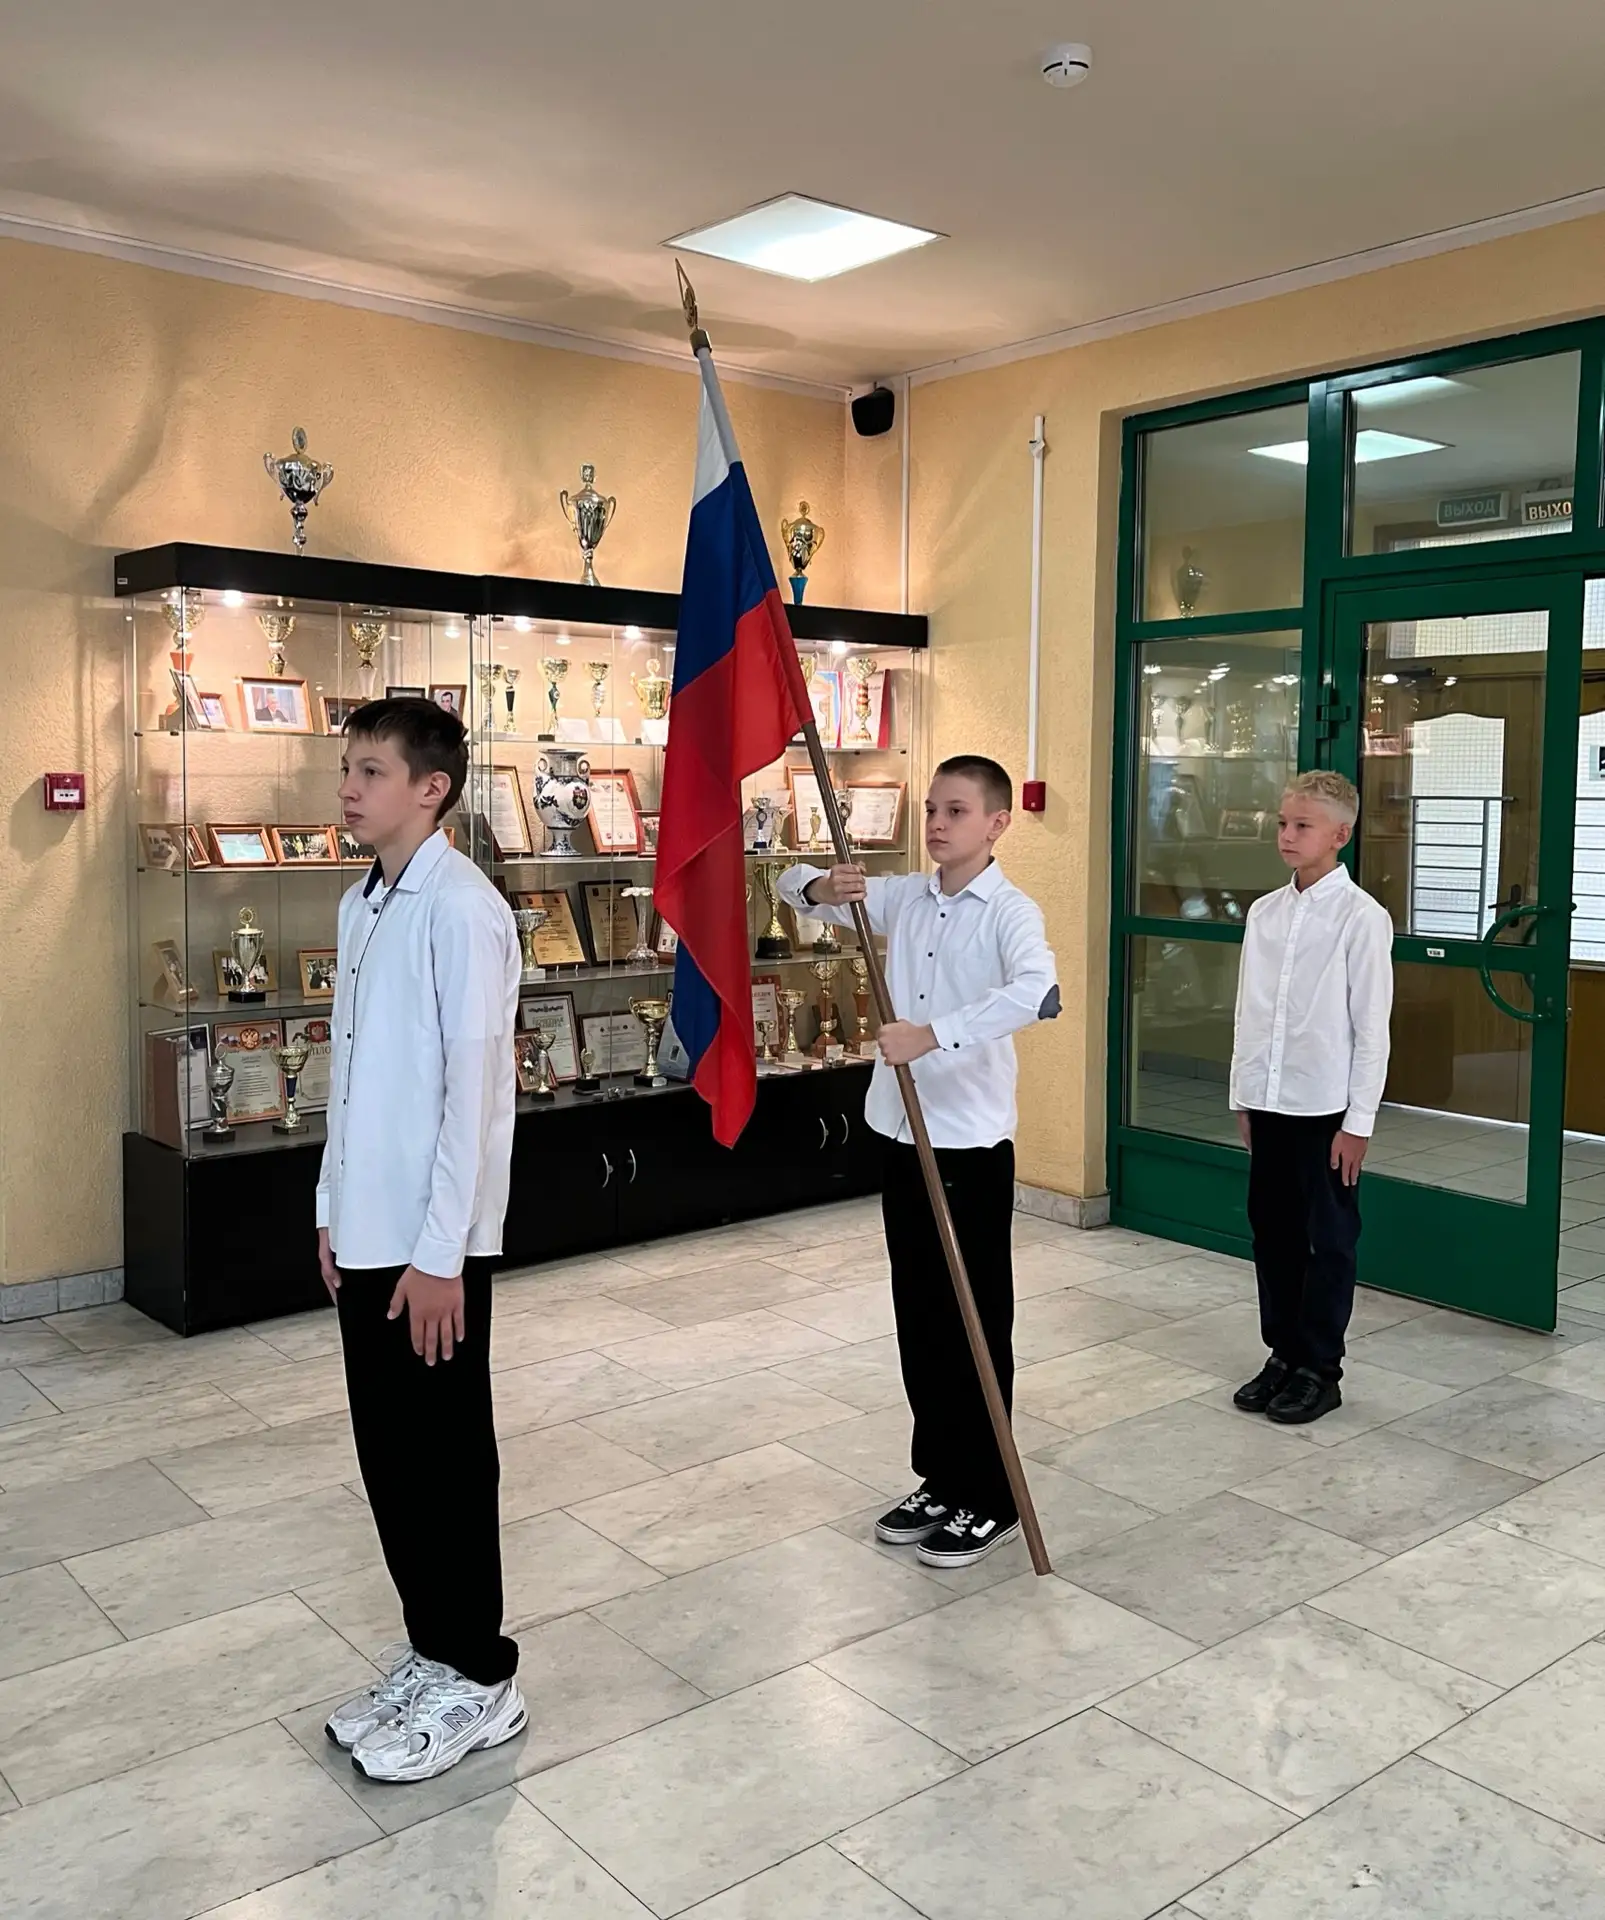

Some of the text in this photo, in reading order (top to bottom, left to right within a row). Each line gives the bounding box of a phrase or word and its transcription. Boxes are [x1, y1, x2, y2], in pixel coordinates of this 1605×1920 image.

[1444, 500, 1496, 517] ВЫХОД
[1529, 501, 1572, 520] ВЫХО
[441, 1705, 475, 1732] N
